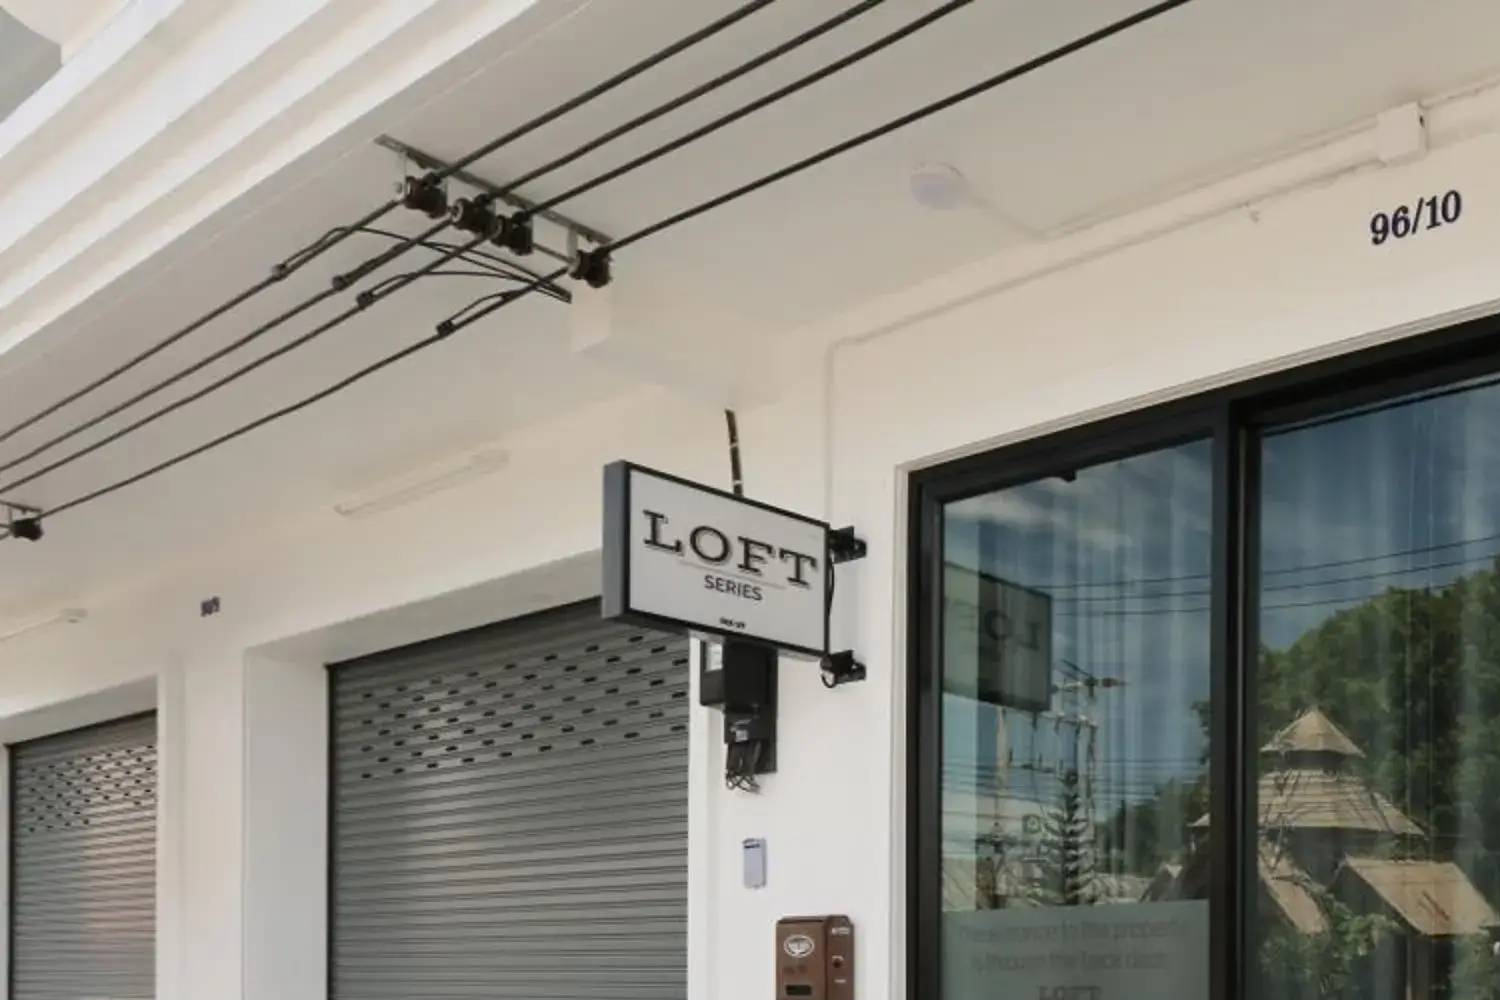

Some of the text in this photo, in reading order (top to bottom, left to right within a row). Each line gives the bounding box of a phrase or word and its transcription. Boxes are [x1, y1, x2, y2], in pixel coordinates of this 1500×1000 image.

[1370, 189, 1462, 246] 96/10
[642, 509, 818, 590] LOFT
[703, 574, 763, 601] SERIES
